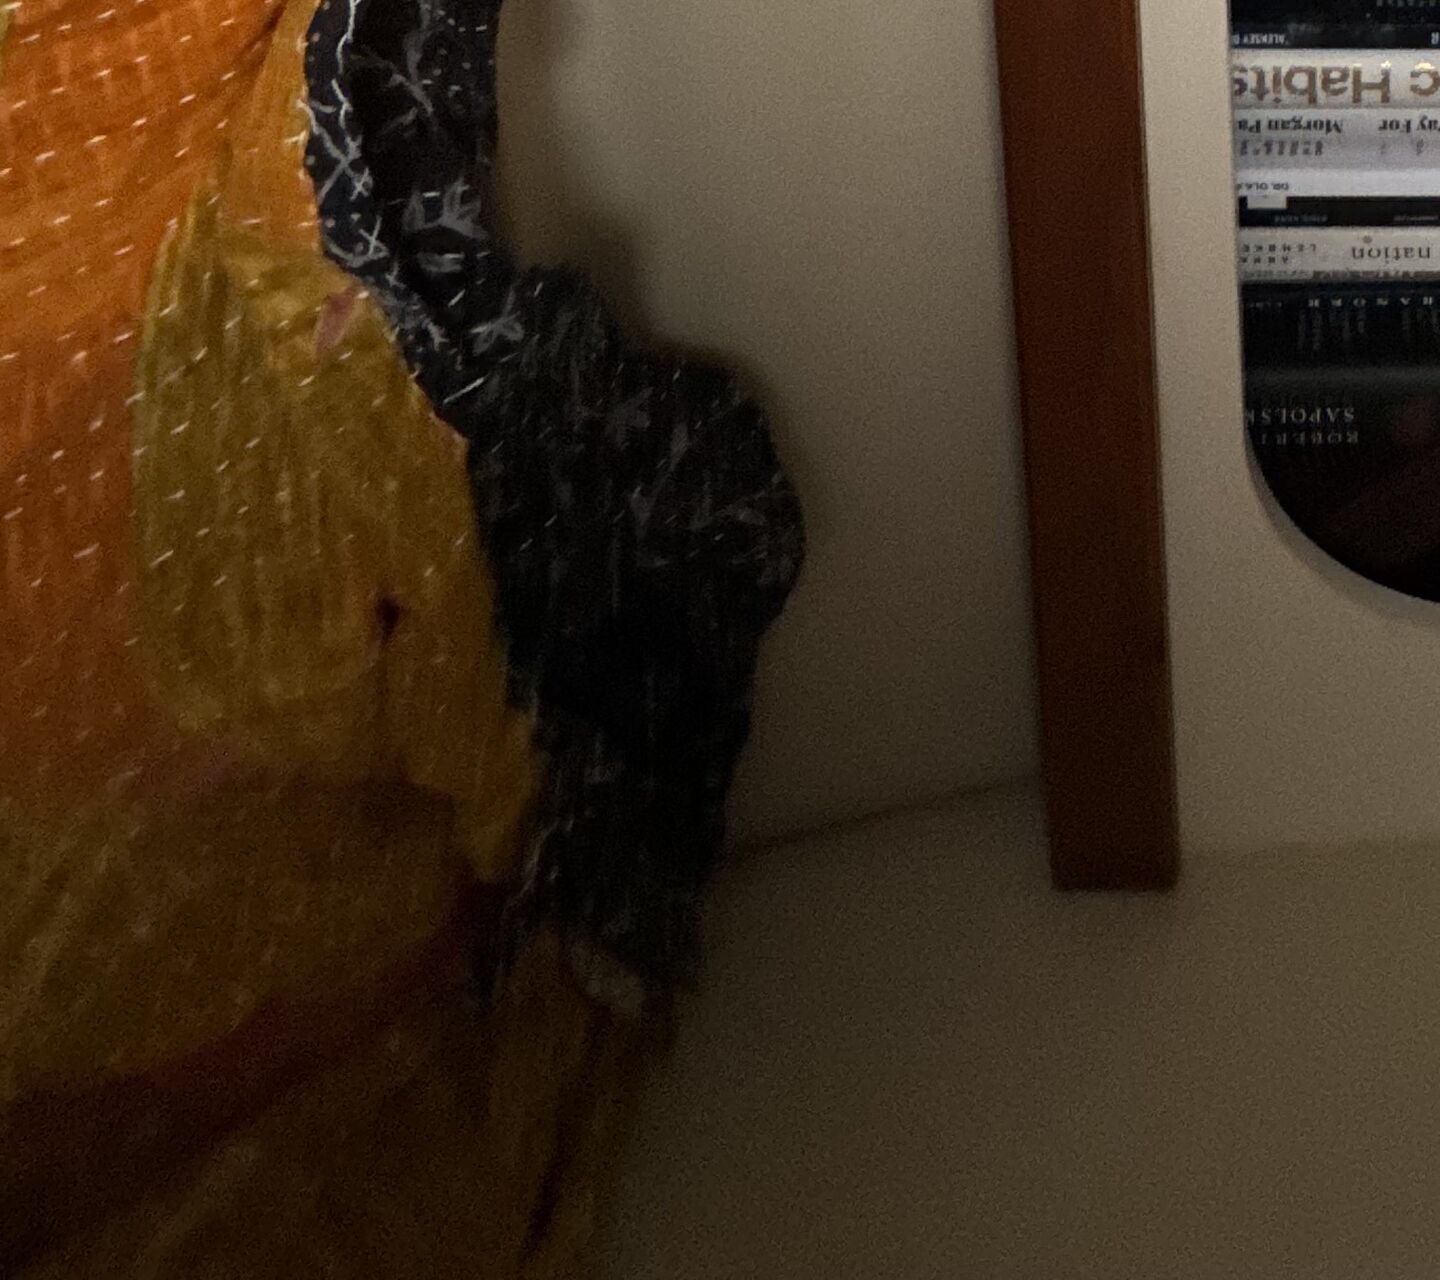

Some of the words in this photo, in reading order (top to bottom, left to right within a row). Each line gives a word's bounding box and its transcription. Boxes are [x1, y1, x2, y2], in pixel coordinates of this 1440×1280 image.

[1232, 61, 1392, 104] Habits
[1268, 116, 1344, 135] Morgan
[1378, 120, 1412, 134] For
[1352, 246, 1431, 264] nation
[1260, 430, 1359, 445] ROBERT
